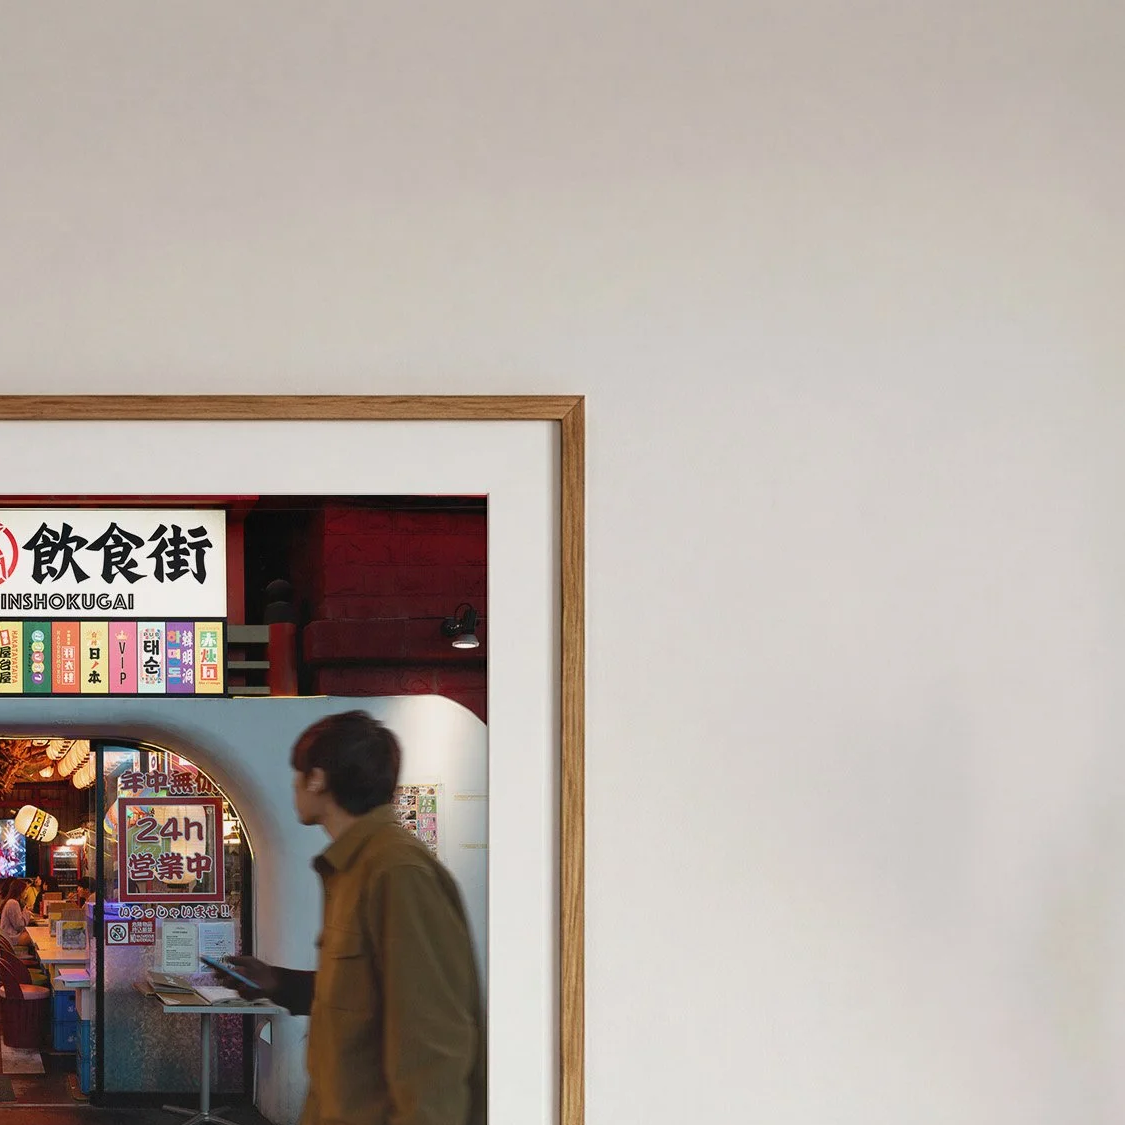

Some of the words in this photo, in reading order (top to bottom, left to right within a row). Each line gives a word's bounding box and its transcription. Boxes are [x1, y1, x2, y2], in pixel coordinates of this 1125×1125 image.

[21, 521, 213, 585] 飲食街
[0, 592, 134, 611] INSHOKUGAI
[88, 647, 102, 684] 日ノ本
[118, 641, 127, 685] VIP
[143, 639, 160, 675] 태순
[136, 816, 204, 842] 24h
[128, 851, 213, 881] 営業中
